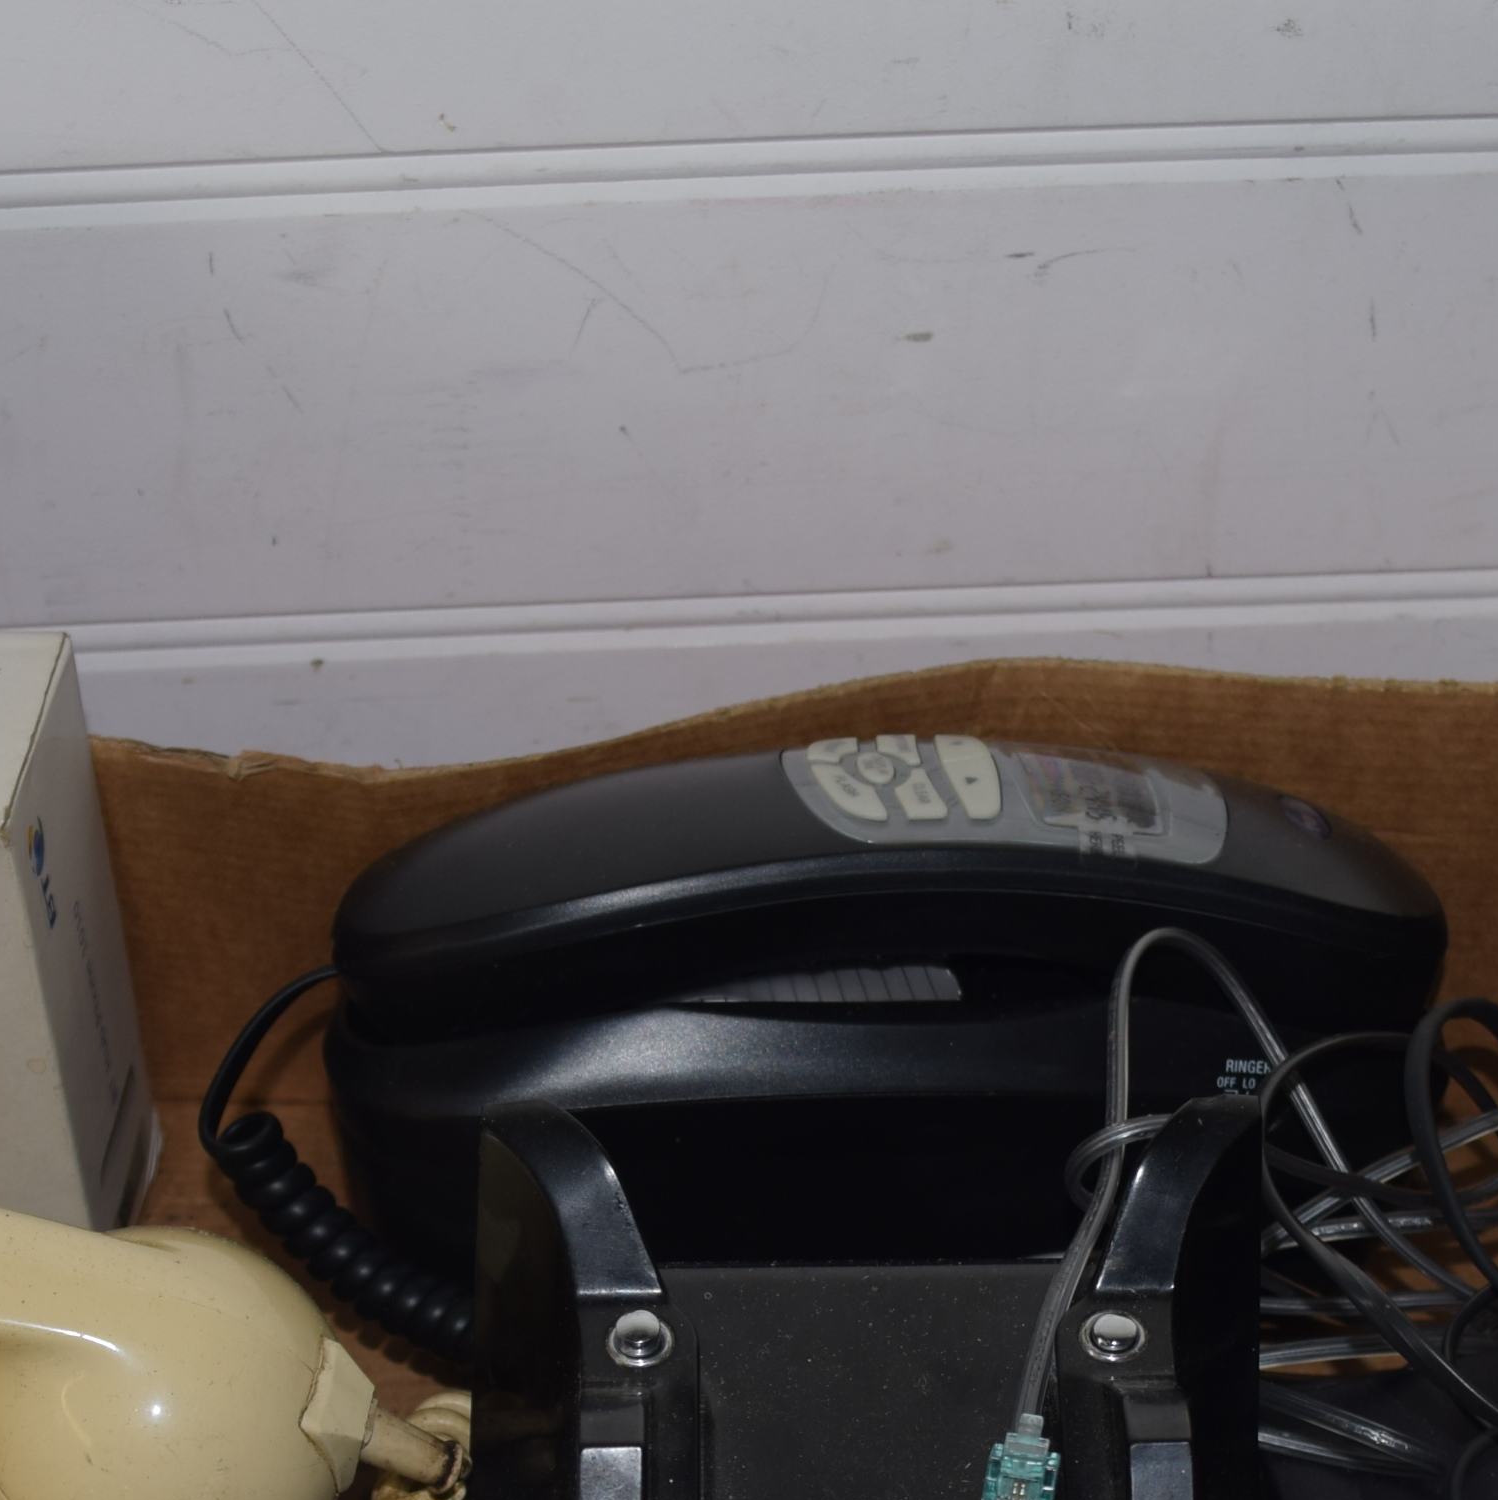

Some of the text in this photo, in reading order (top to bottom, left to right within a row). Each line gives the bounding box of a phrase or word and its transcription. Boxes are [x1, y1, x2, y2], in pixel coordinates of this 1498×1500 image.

[40, 874, 56, 929] BT
[1216, 1076, 1256, 1090] OFF LO
